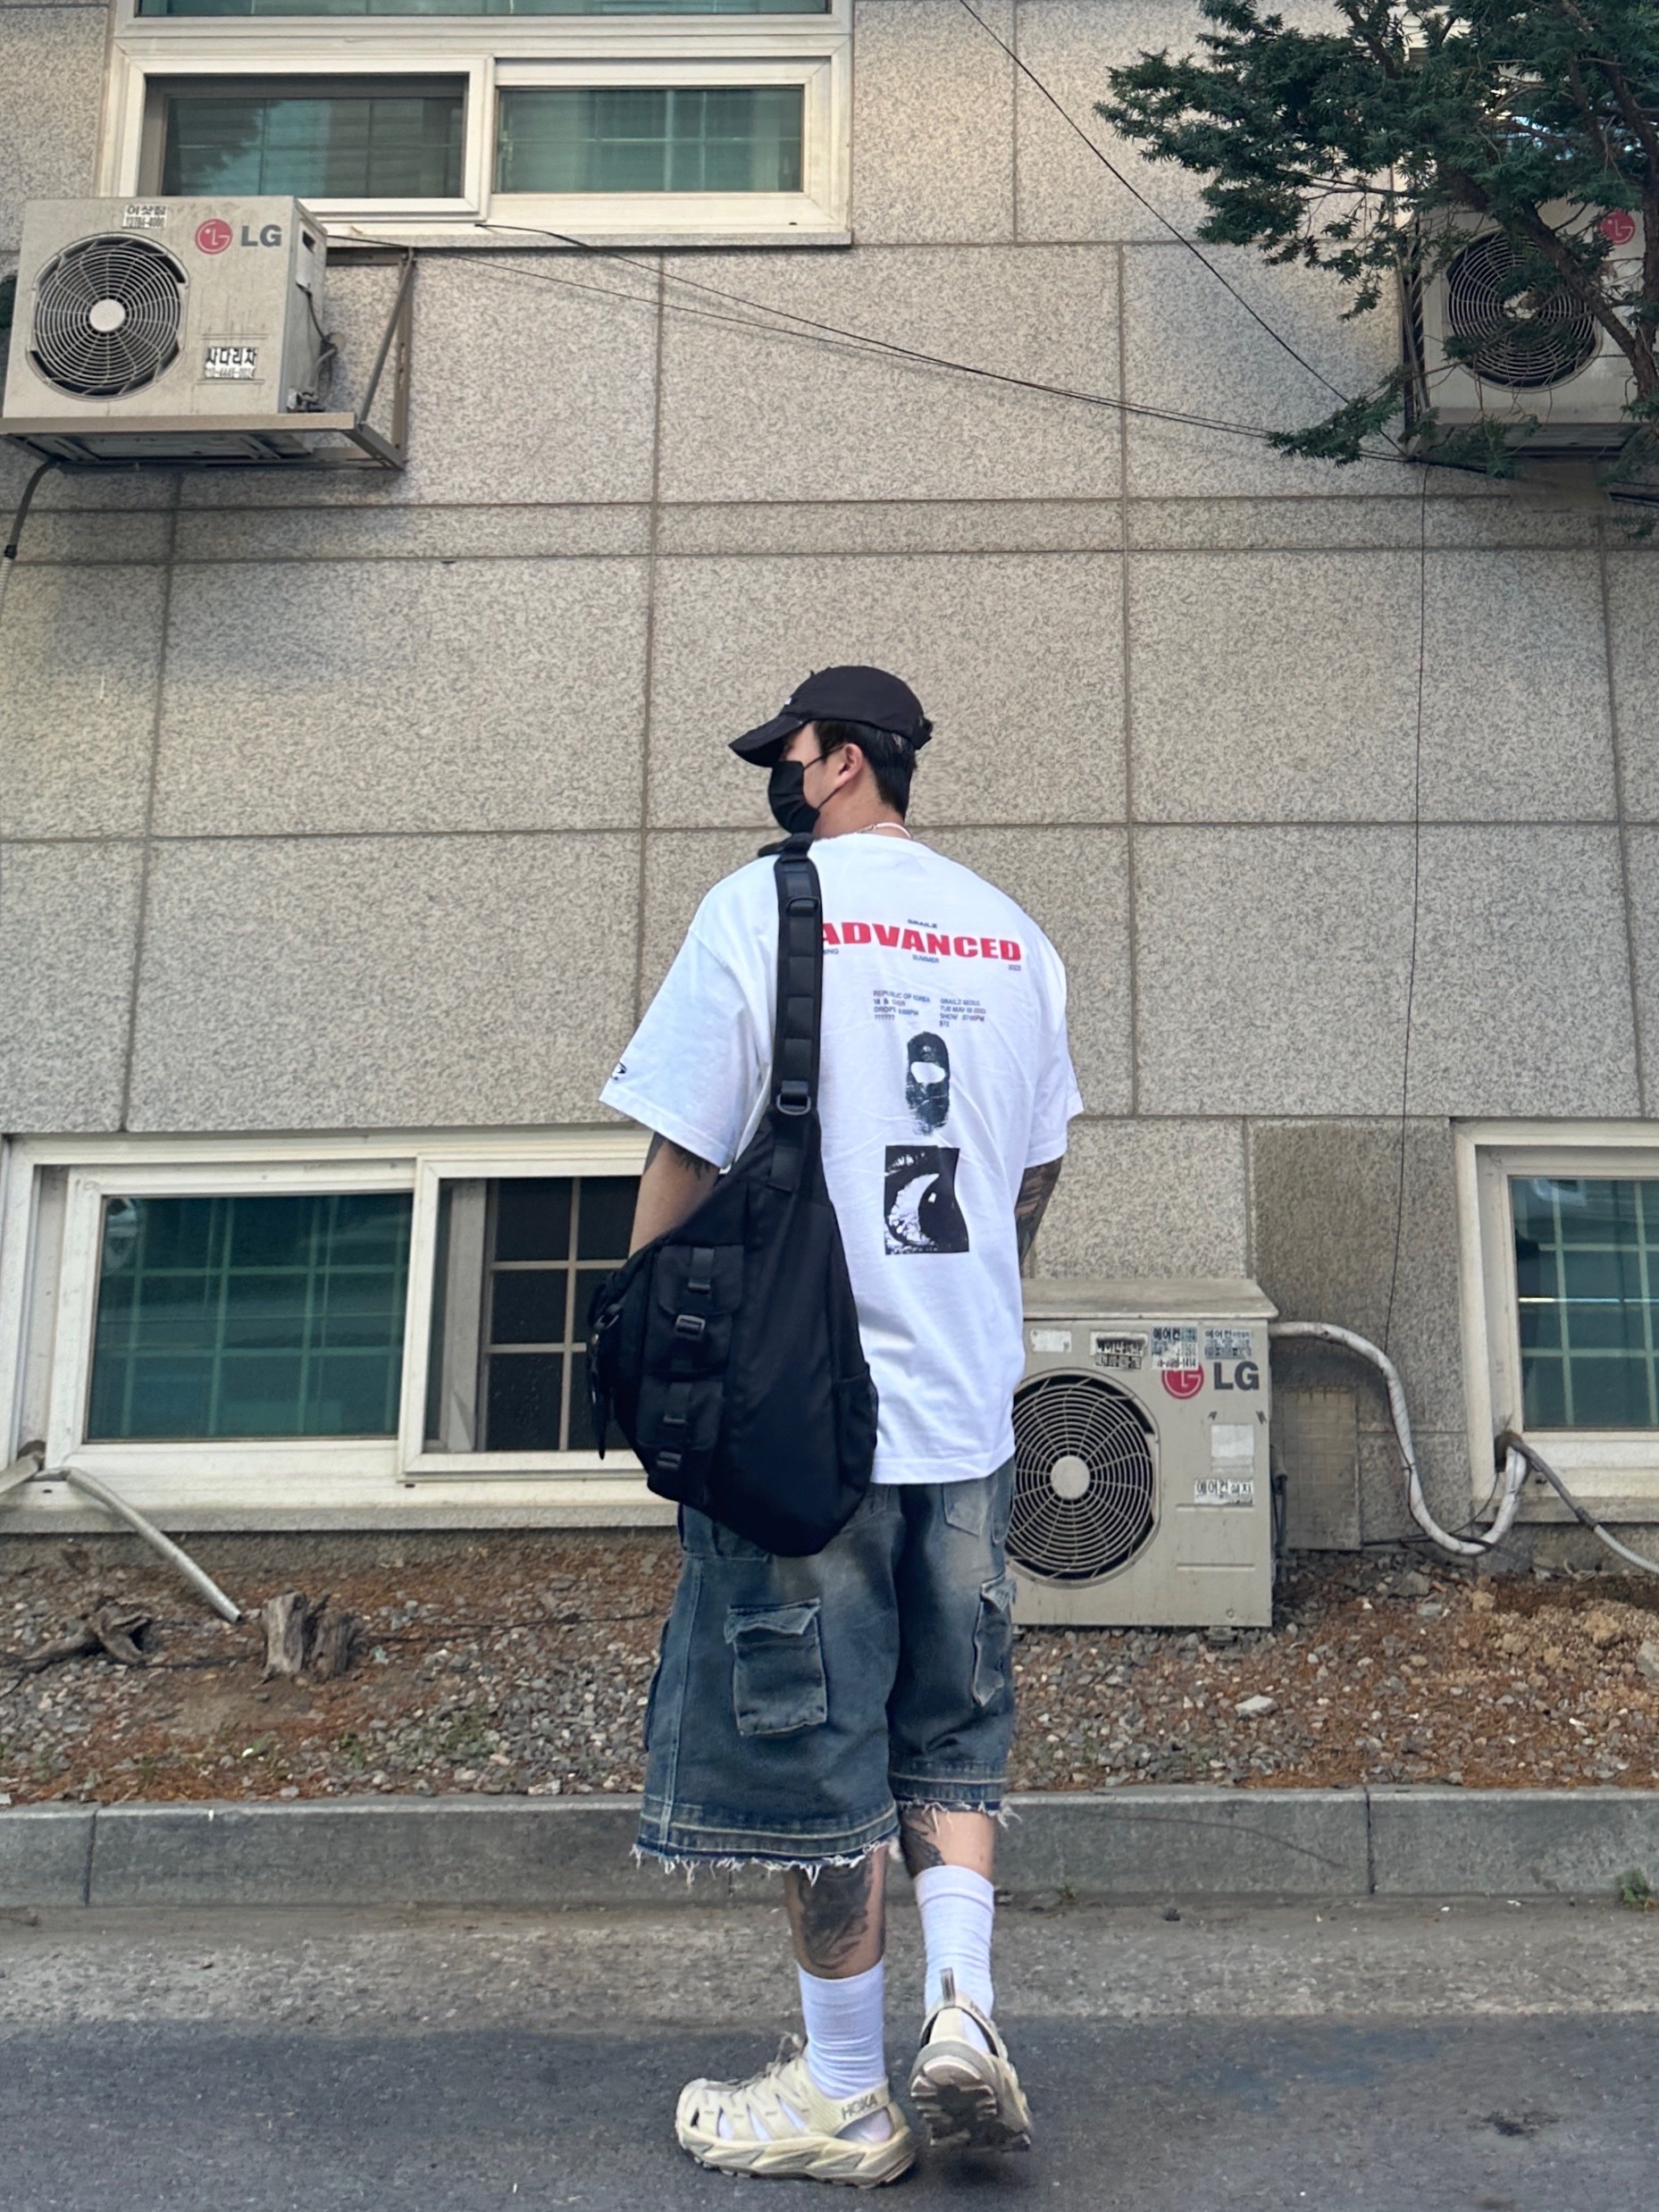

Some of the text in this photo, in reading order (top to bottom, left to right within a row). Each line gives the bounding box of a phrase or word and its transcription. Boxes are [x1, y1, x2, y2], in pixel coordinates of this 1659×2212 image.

[241, 224, 282, 247] LG
[205, 348, 257, 365] 사다리차
[823, 922, 1021, 961] ADVANCED
[912, 954, 939, 963] SUMMER
[1153, 1327, 1180, 1341] 에어컨
[1205, 1329, 1231, 1339] 에어컨
[1213, 1361, 1260, 1391] LG
[842, 2093, 878, 2121] HOKA
